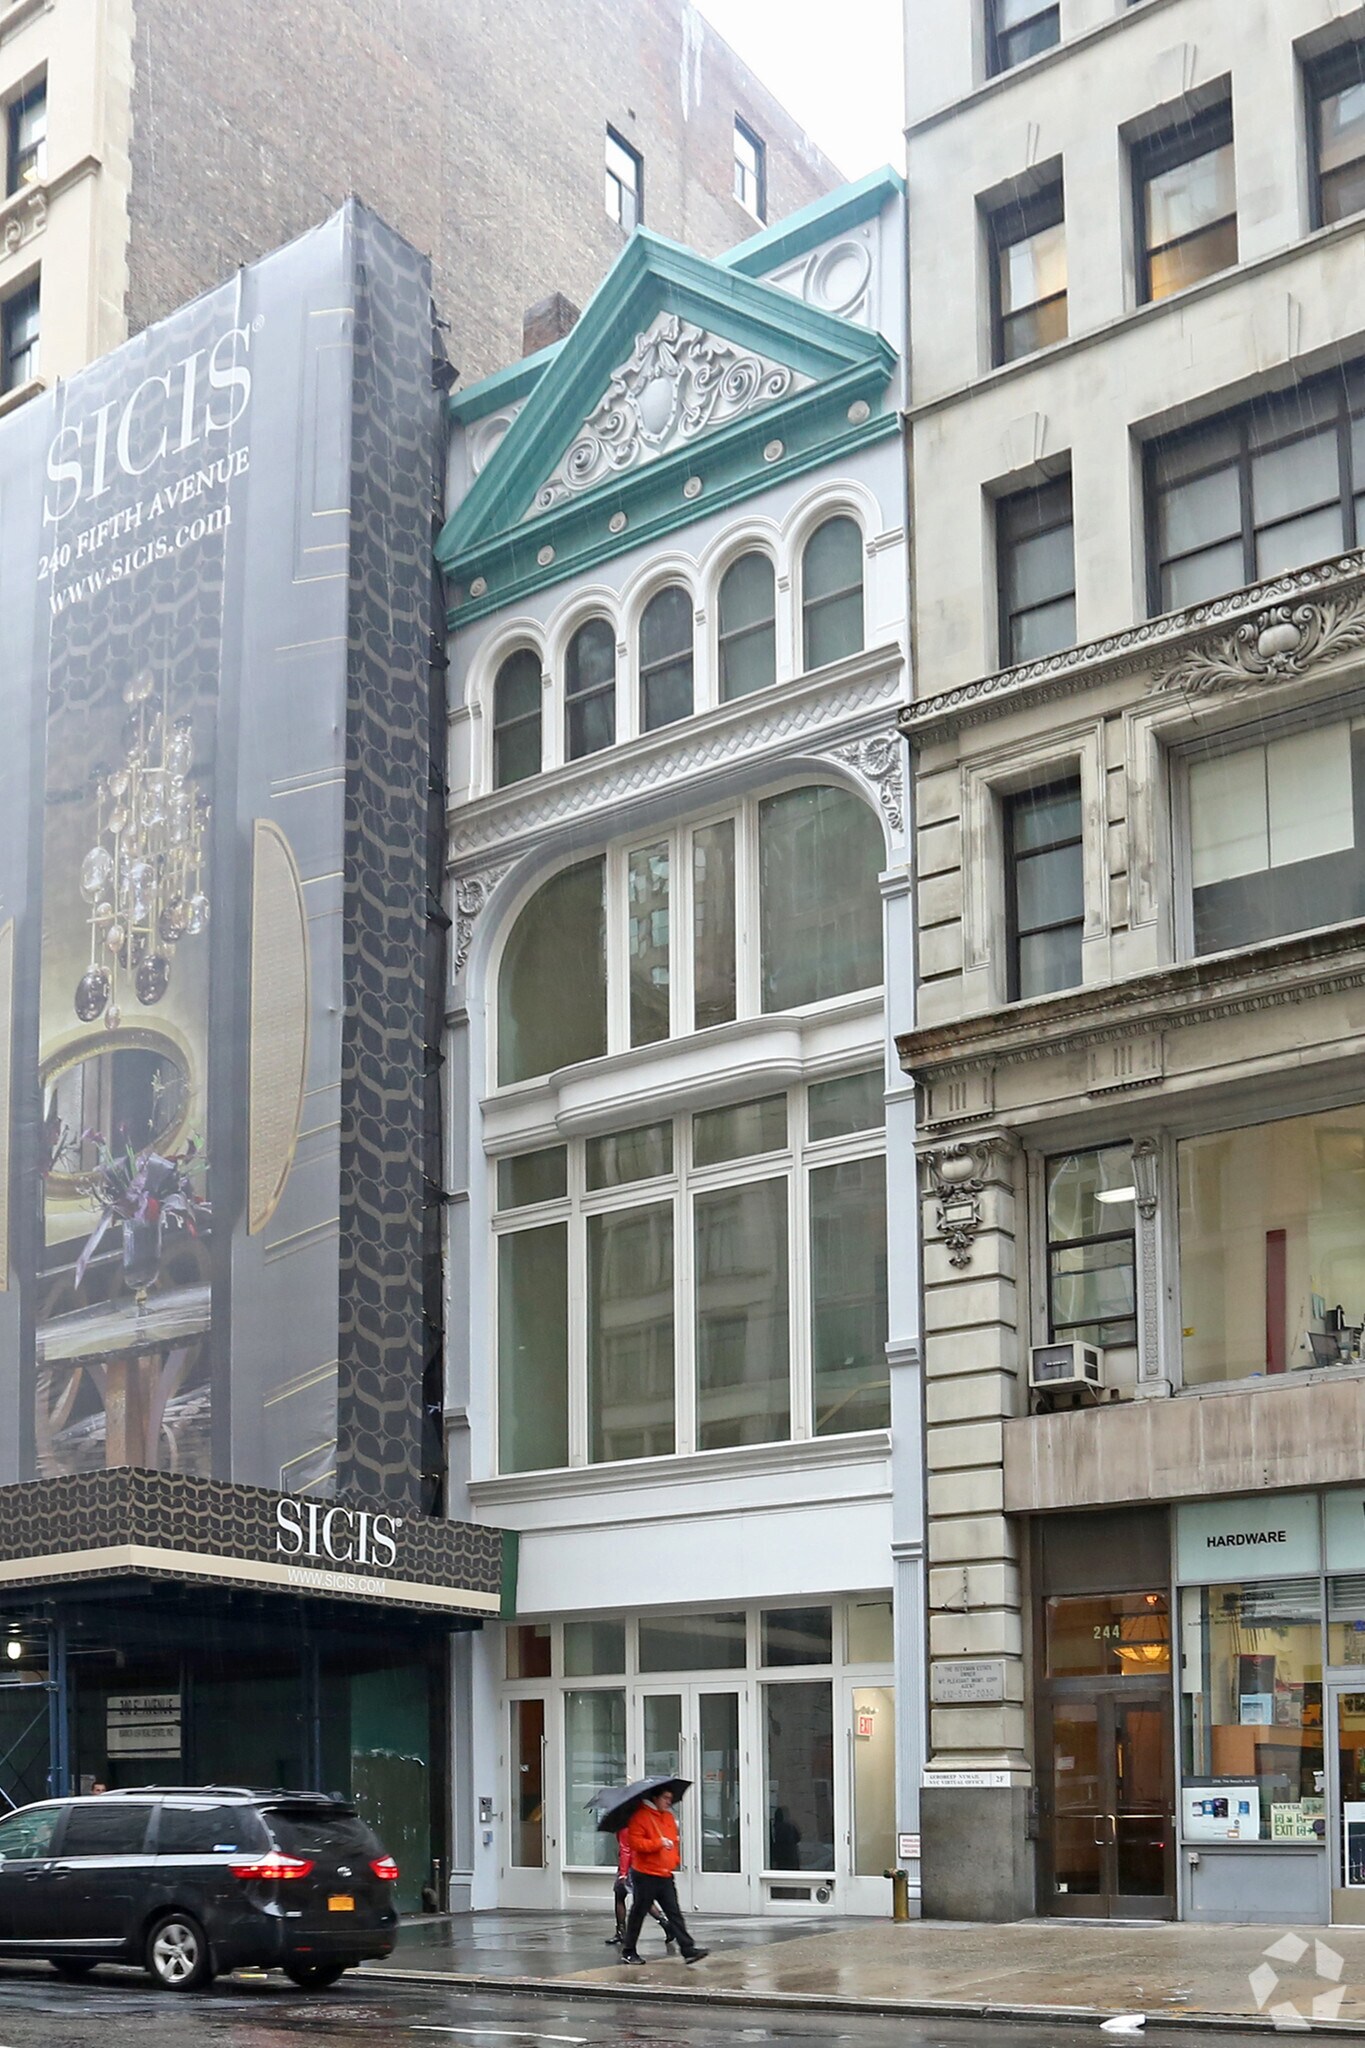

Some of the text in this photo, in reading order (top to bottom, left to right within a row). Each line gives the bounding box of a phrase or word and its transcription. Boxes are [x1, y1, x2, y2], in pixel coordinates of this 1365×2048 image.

[42, 322, 252, 527] SICIS
[37, 446, 250, 581] 240 FIFTH AVENUE
[276, 1498, 397, 1568] SICIS
[1206, 1530, 1287, 1548] HARDWARE
[287, 1568, 386, 1594] WWW.SICIS.COM
[1093, 1624, 1120, 1640] 244
[860, 1716, 873, 1735] EXIT
[995, 1775, 1005, 1783] 2F
[1274, 1825, 1293, 1836] EXIT
